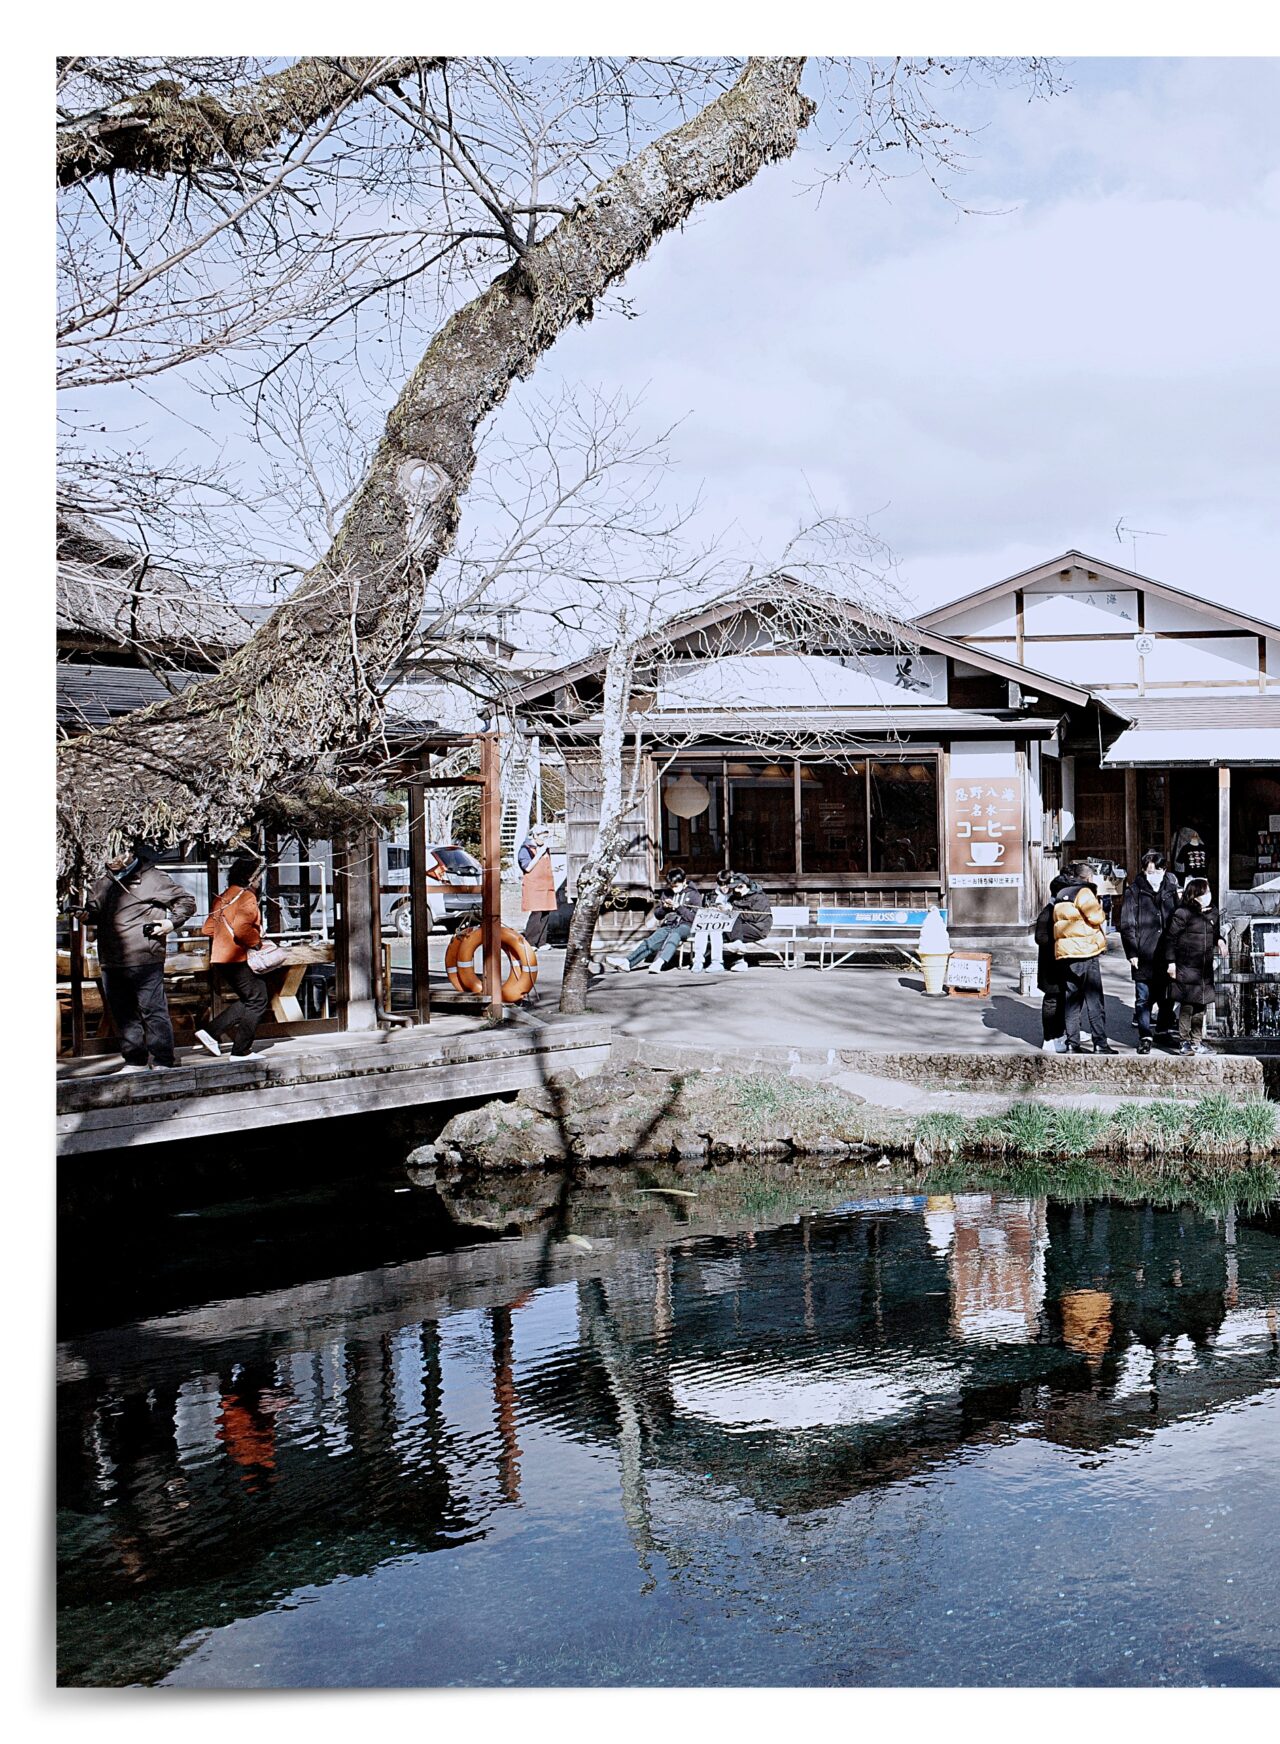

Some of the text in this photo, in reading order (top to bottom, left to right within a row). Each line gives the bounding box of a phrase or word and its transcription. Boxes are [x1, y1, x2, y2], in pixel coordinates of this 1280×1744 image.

[954, 785, 1016, 802] 忍野八海
[970, 804, 997, 817] 名水
[956, 820, 1017, 838] コーヒー
[694, 921, 731, 931] STOP
